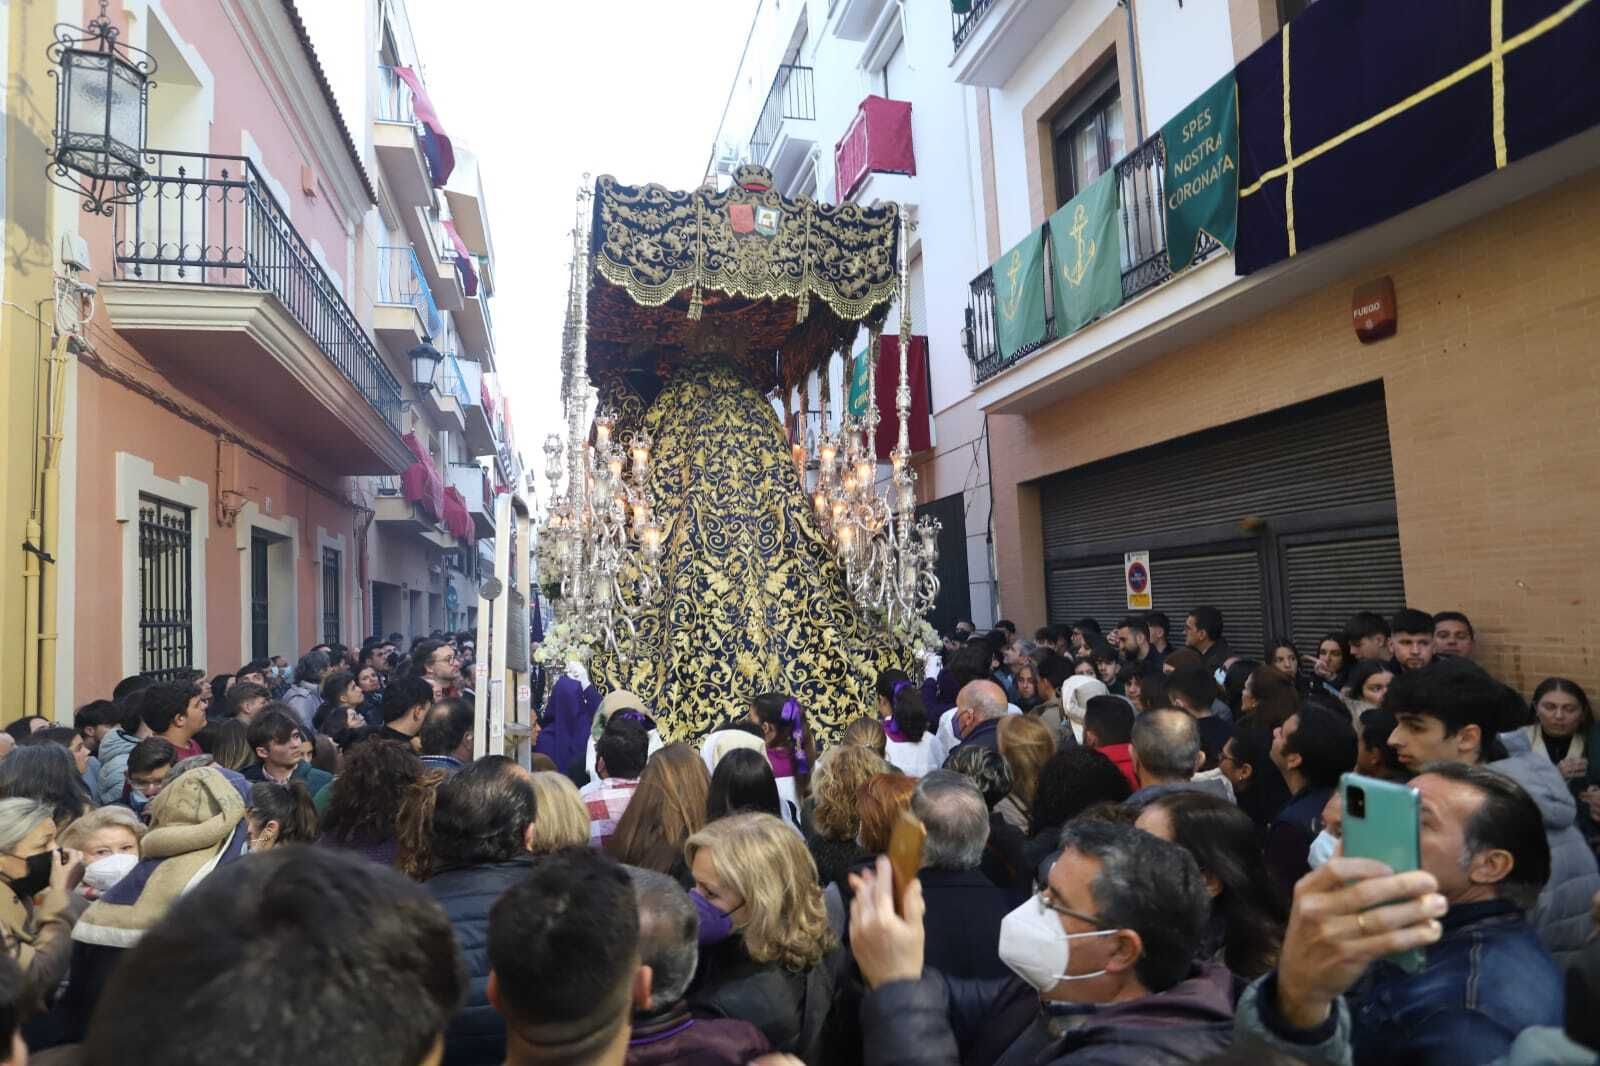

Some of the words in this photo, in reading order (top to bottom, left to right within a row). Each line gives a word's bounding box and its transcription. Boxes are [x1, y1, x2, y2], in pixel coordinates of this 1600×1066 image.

[1182, 107, 1212, 143] SPES
[1174, 132, 1222, 178] NOSTRA
[1168, 154, 1235, 210] CORONATA
